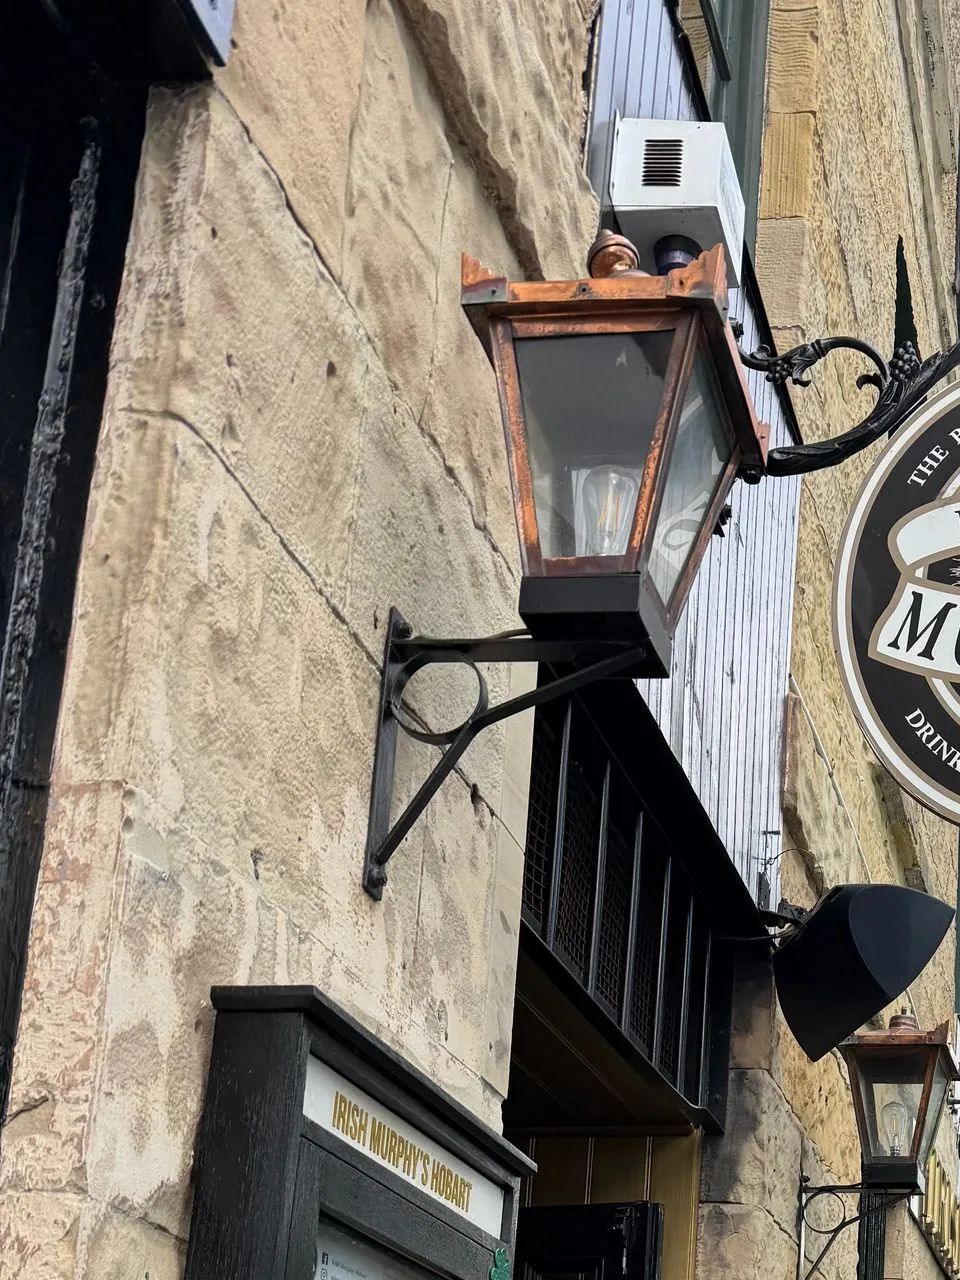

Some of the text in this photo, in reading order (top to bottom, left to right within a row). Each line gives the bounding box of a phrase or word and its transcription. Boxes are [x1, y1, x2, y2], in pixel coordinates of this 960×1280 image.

[906, 445, 949, 488] THE
[332, 1091, 473, 1213] IRISH MURPHY'S HOBART
